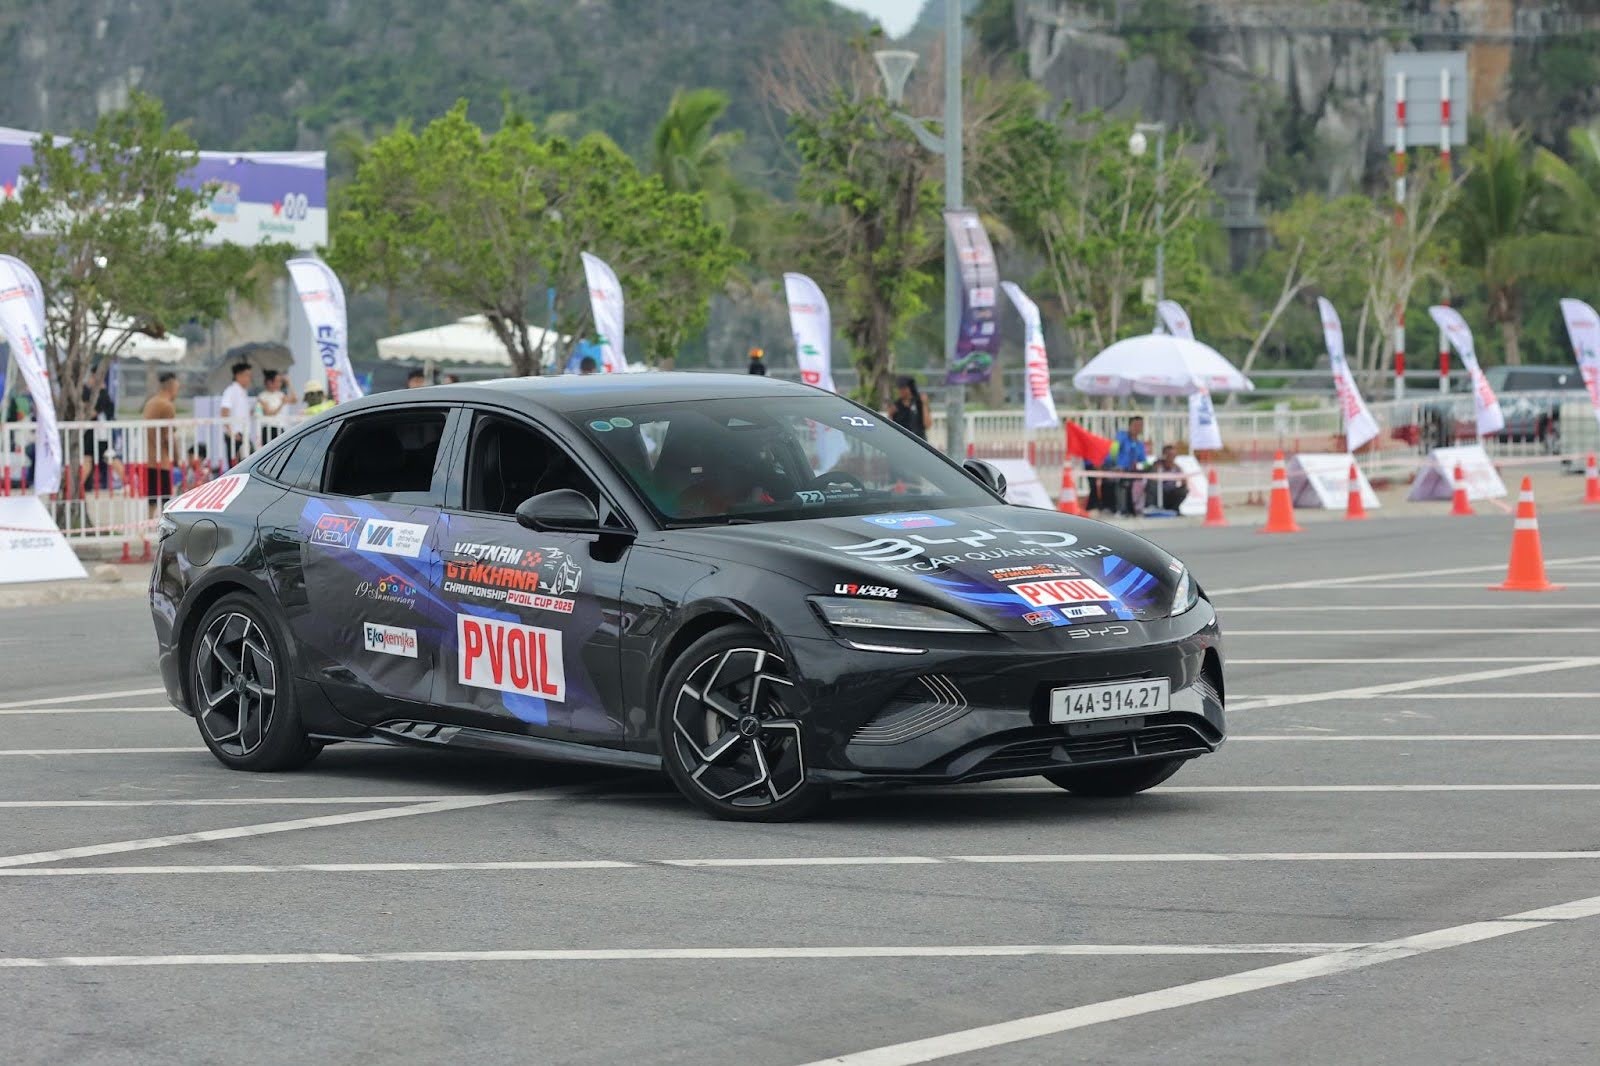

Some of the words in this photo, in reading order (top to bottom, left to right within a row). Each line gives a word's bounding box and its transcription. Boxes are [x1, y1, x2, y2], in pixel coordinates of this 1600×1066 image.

[841, 416, 875, 427] 22
[168, 477, 240, 510] PVOIL
[801, 492, 823, 503] 22
[314, 529, 348, 547] MEDIA
[454, 542, 523, 565] VIETNAM
[447, 561, 539, 592] GYMKHANA
[444, 582, 507, 601] CHAMPIONSHIP
[508, 592, 534, 603] PVOIL
[535, 597, 552, 608] CUP
[553, 600, 573, 612] 2025
[1016, 579, 1109, 605] PVOIL
[366, 627, 415, 653] Ekokemika
[1067, 626, 1129, 639] BYD
[463, 620, 558, 696] PVOIL
[1064, 686, 1161, 715] 14A-914.27
